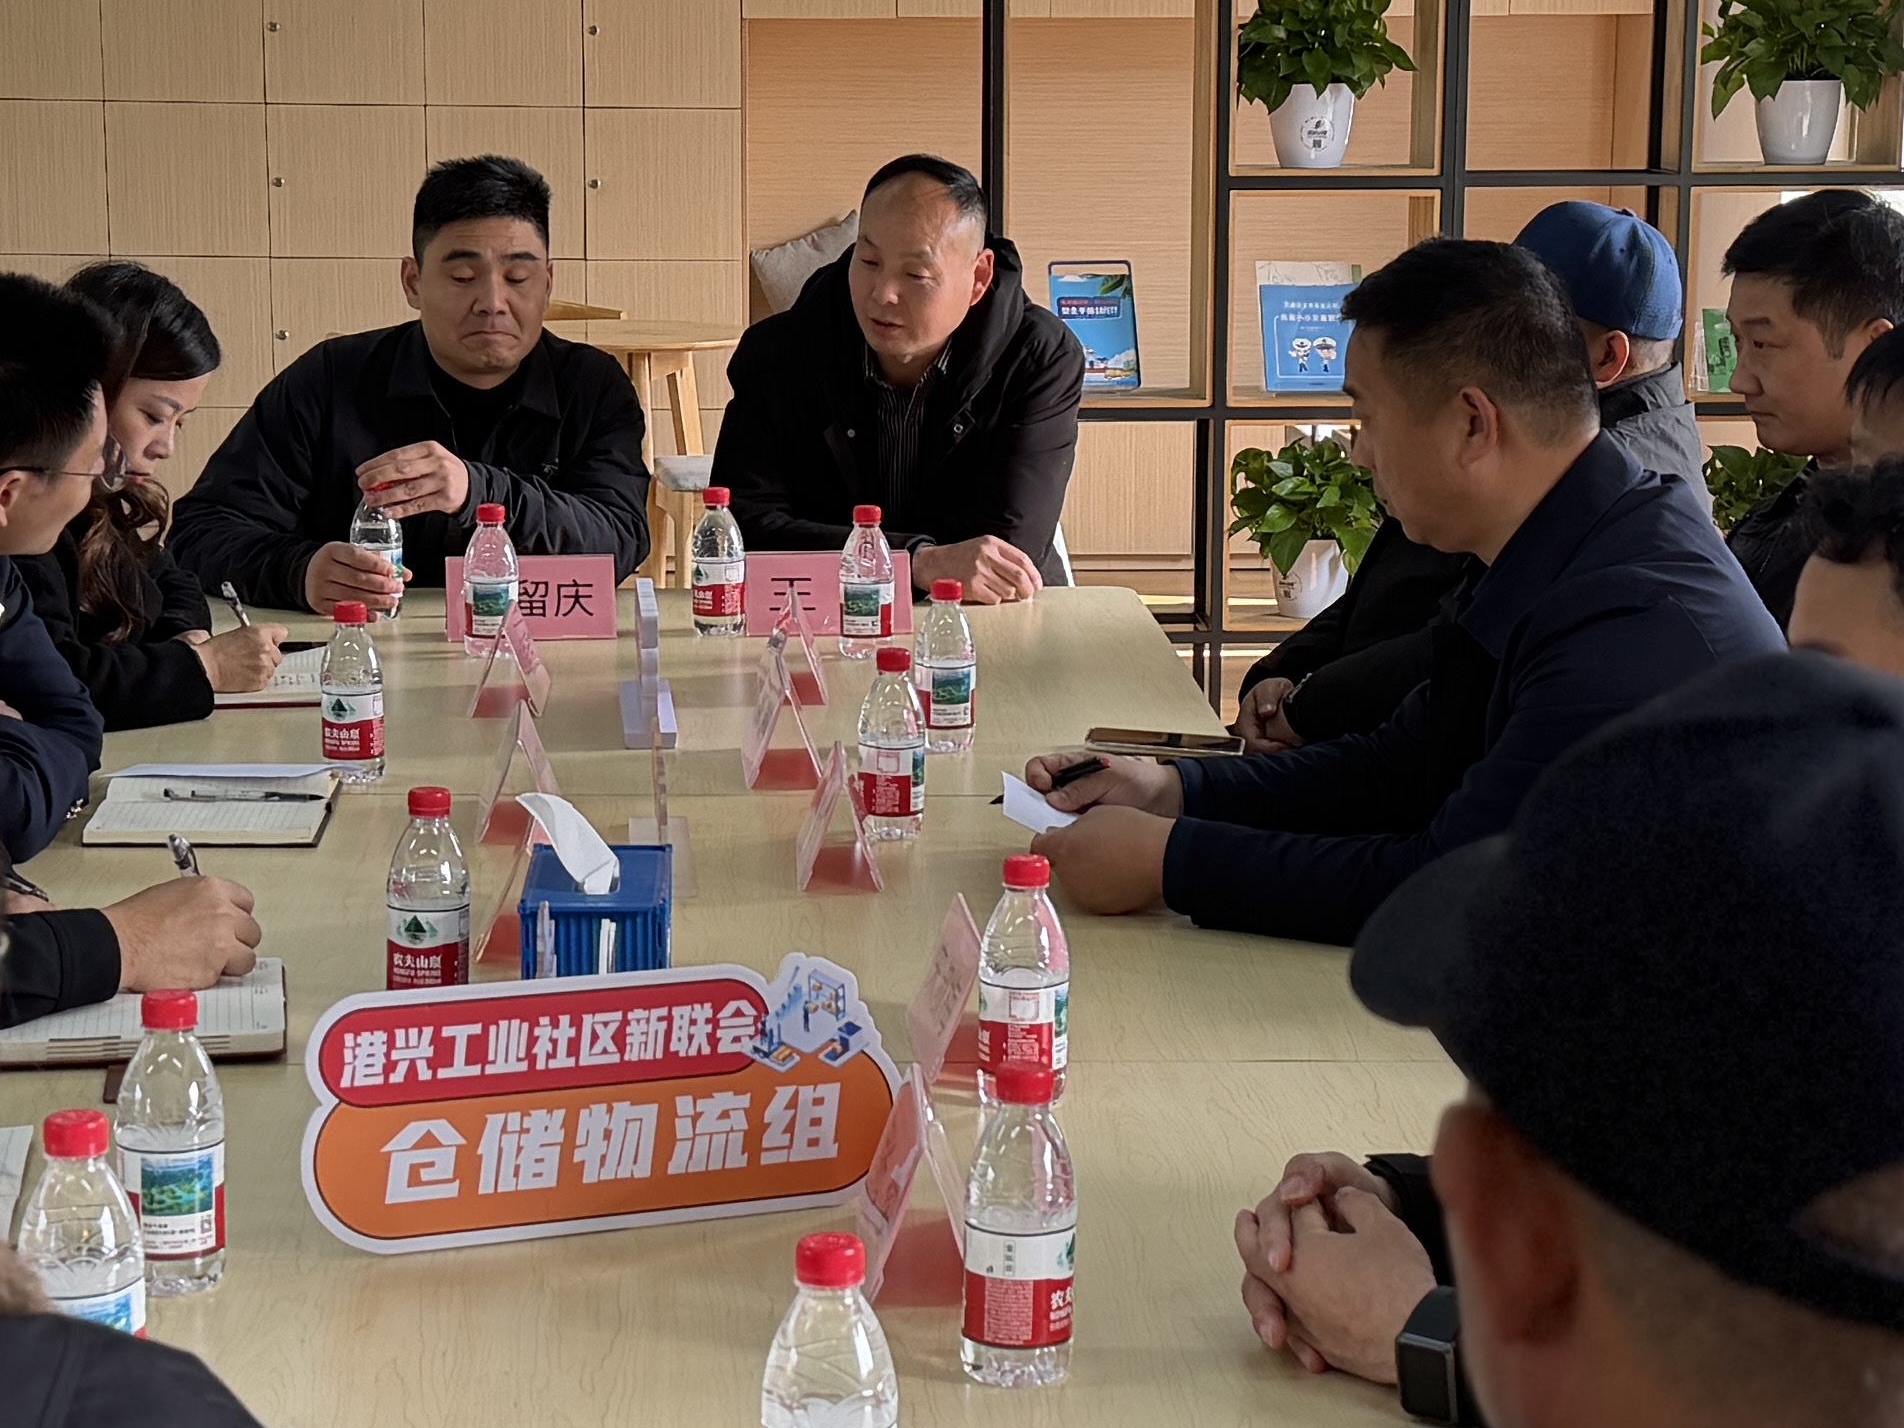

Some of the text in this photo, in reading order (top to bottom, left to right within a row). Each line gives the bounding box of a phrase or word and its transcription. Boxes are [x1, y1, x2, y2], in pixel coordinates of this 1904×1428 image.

[339, 999, 761, 1089] 港兴工业社区新联会
[380, 1081, 842, 1205] 仓储物流组
